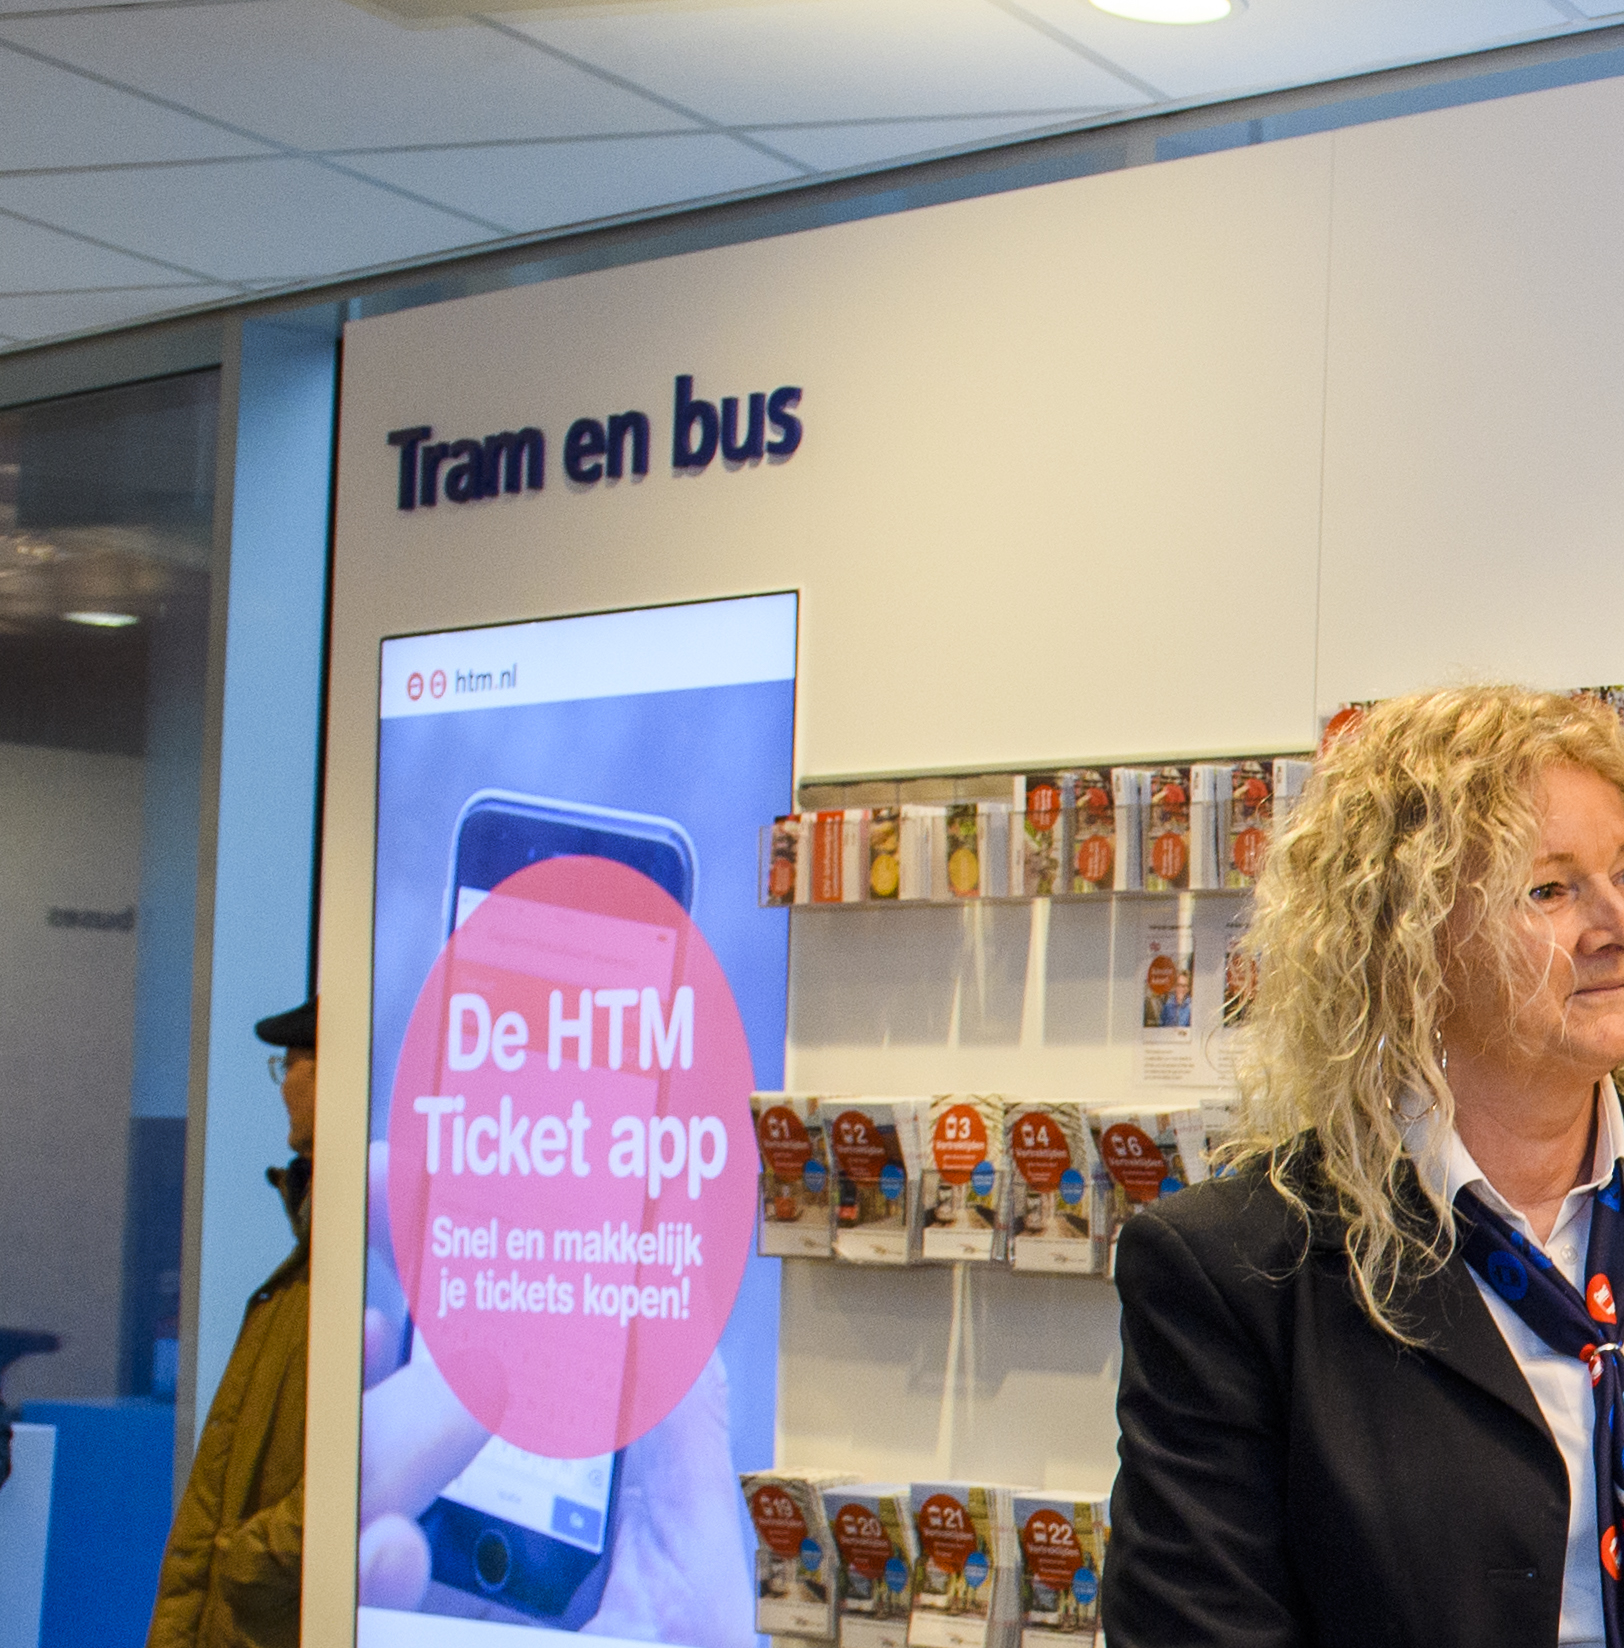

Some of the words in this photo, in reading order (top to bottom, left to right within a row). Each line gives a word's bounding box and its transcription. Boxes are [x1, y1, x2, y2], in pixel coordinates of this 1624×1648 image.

[387, 425, 546, 511] Tram
[563, 409, 650, 484] en
[672, 374, 803, 470] bus
[455, 662, 517, 693] htm.nl
[448, 993, 529, 1072] De
[547, 985, 695, 1071] HTM
[854, 1123, 868, 1144] 2
[958, 1117, 972, 1140] 3
[1037, 1125, 1050, 1147] 4
[412, 1094, 592, 1178] Ticket
[608, 1115, 728, 1200] app
[1126, 1135, 1144, 1158] 6
[431, 1214, 499, 1259] Snel
[506, 1227, 546, 1261] en
[553, 1219, 703, 1277] makkelijk
[437, 1266, 467, 1319] je
[474, 1268, 575, 1315] tickets
[582, 1272, 691, 1328] kopen!
[942, 1507, 966, 1530] 21
[1045, 1523, 1074, 1547] 22
